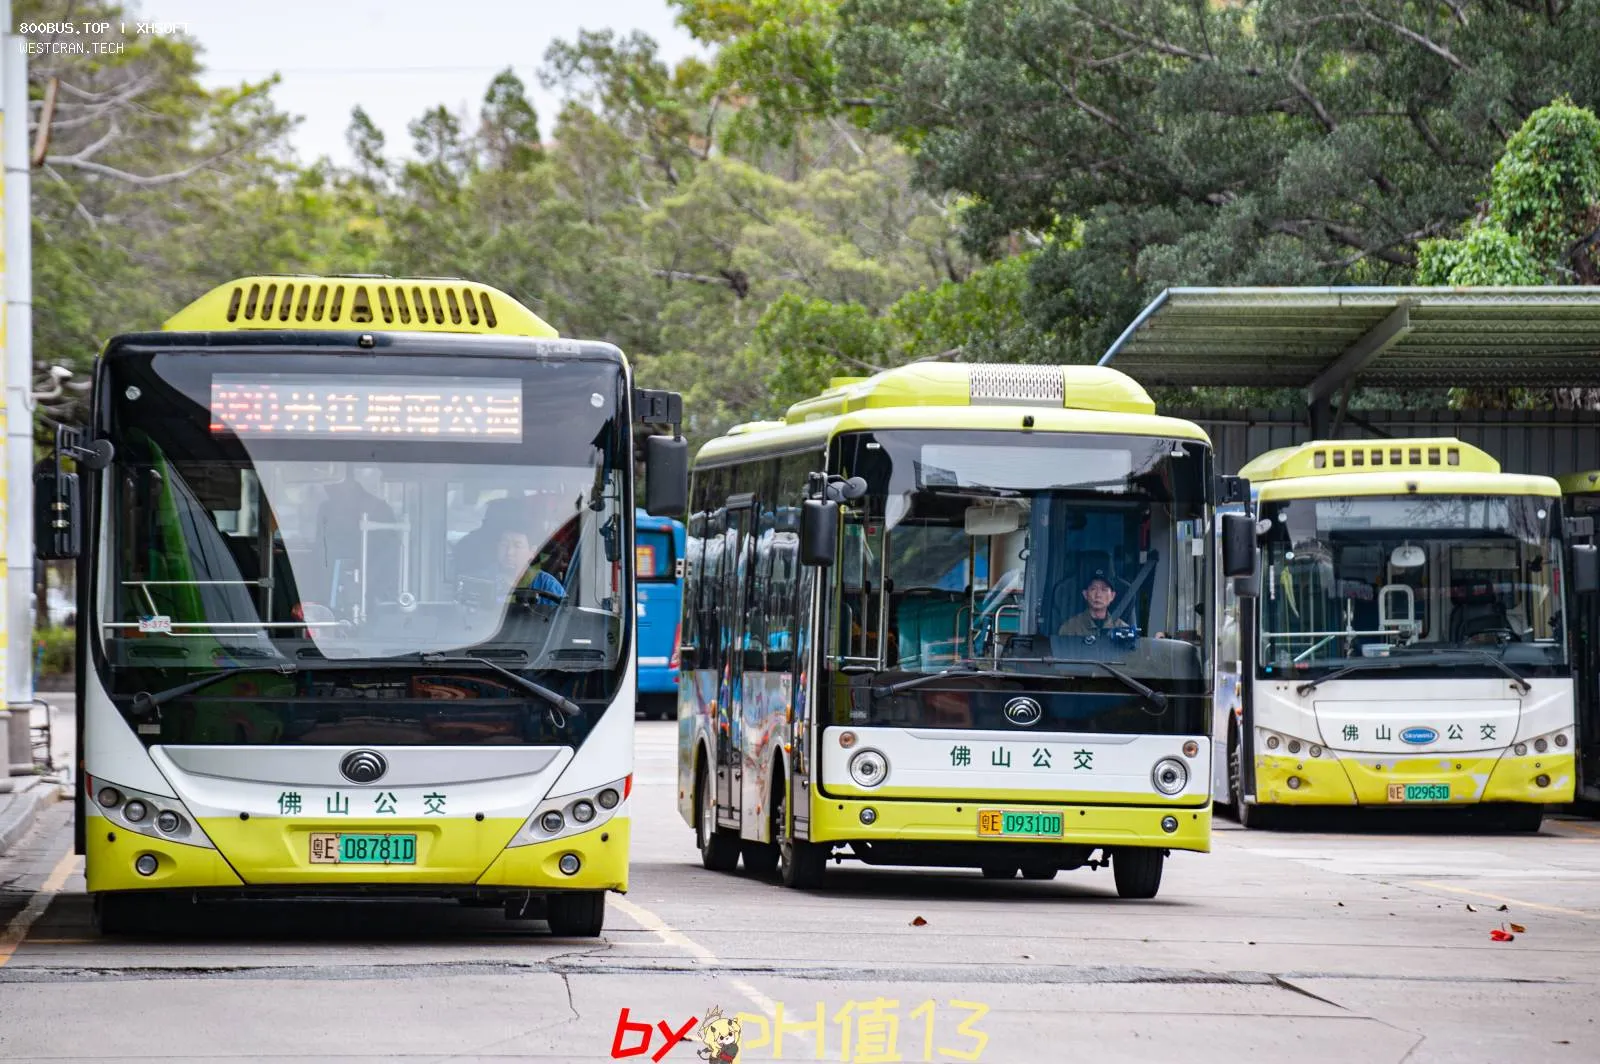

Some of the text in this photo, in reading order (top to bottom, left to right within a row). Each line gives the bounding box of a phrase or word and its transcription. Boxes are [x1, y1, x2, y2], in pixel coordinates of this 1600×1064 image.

[1342, 723, 1392, 741] 佛山
[1447, 723, 1497, 741] 公交
[950, 745, 1094, 770] 佛山公交
[278, 791, 447, 815] 佛山公交
[1006, 815, 1061, 834] 09310D
[344, 837, 414, 860] 08781D
